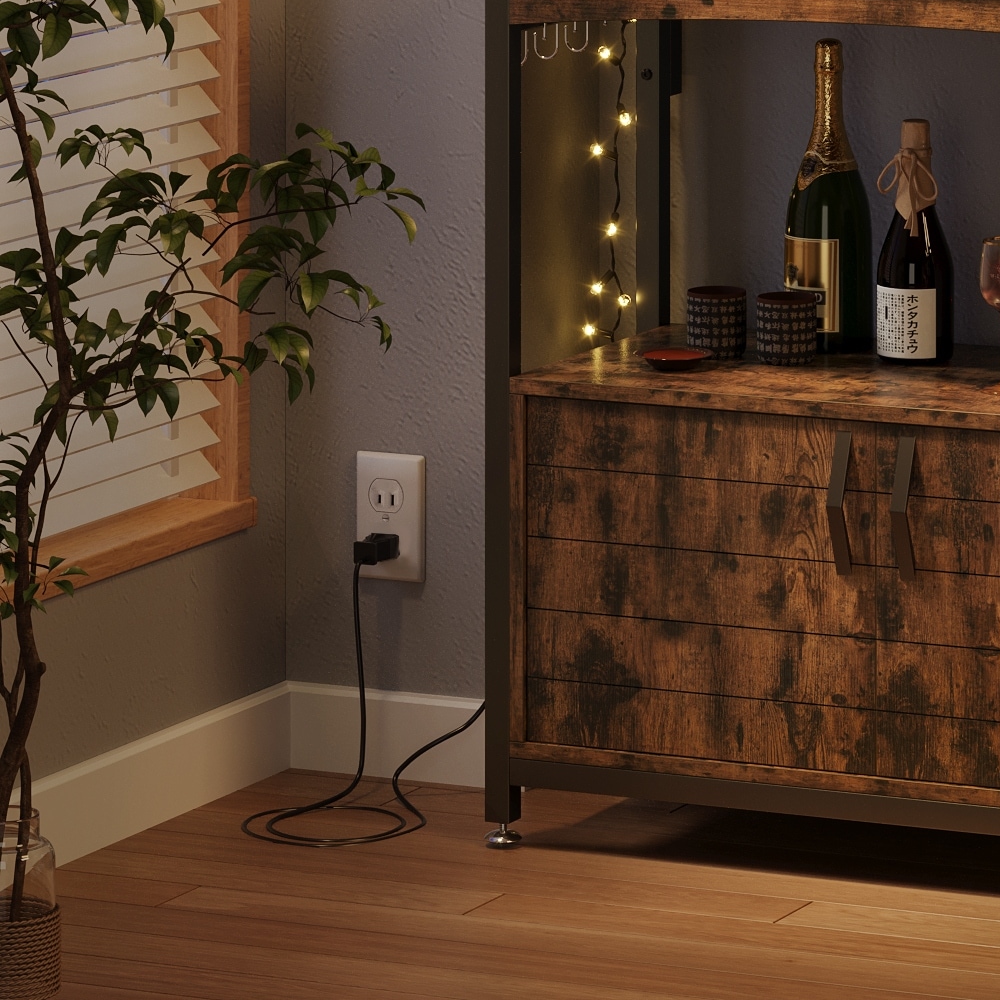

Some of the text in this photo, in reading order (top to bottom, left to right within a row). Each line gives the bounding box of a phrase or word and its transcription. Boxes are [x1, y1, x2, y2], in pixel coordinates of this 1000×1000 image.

[906, 294, 919, 354] ホンタカチュウ
